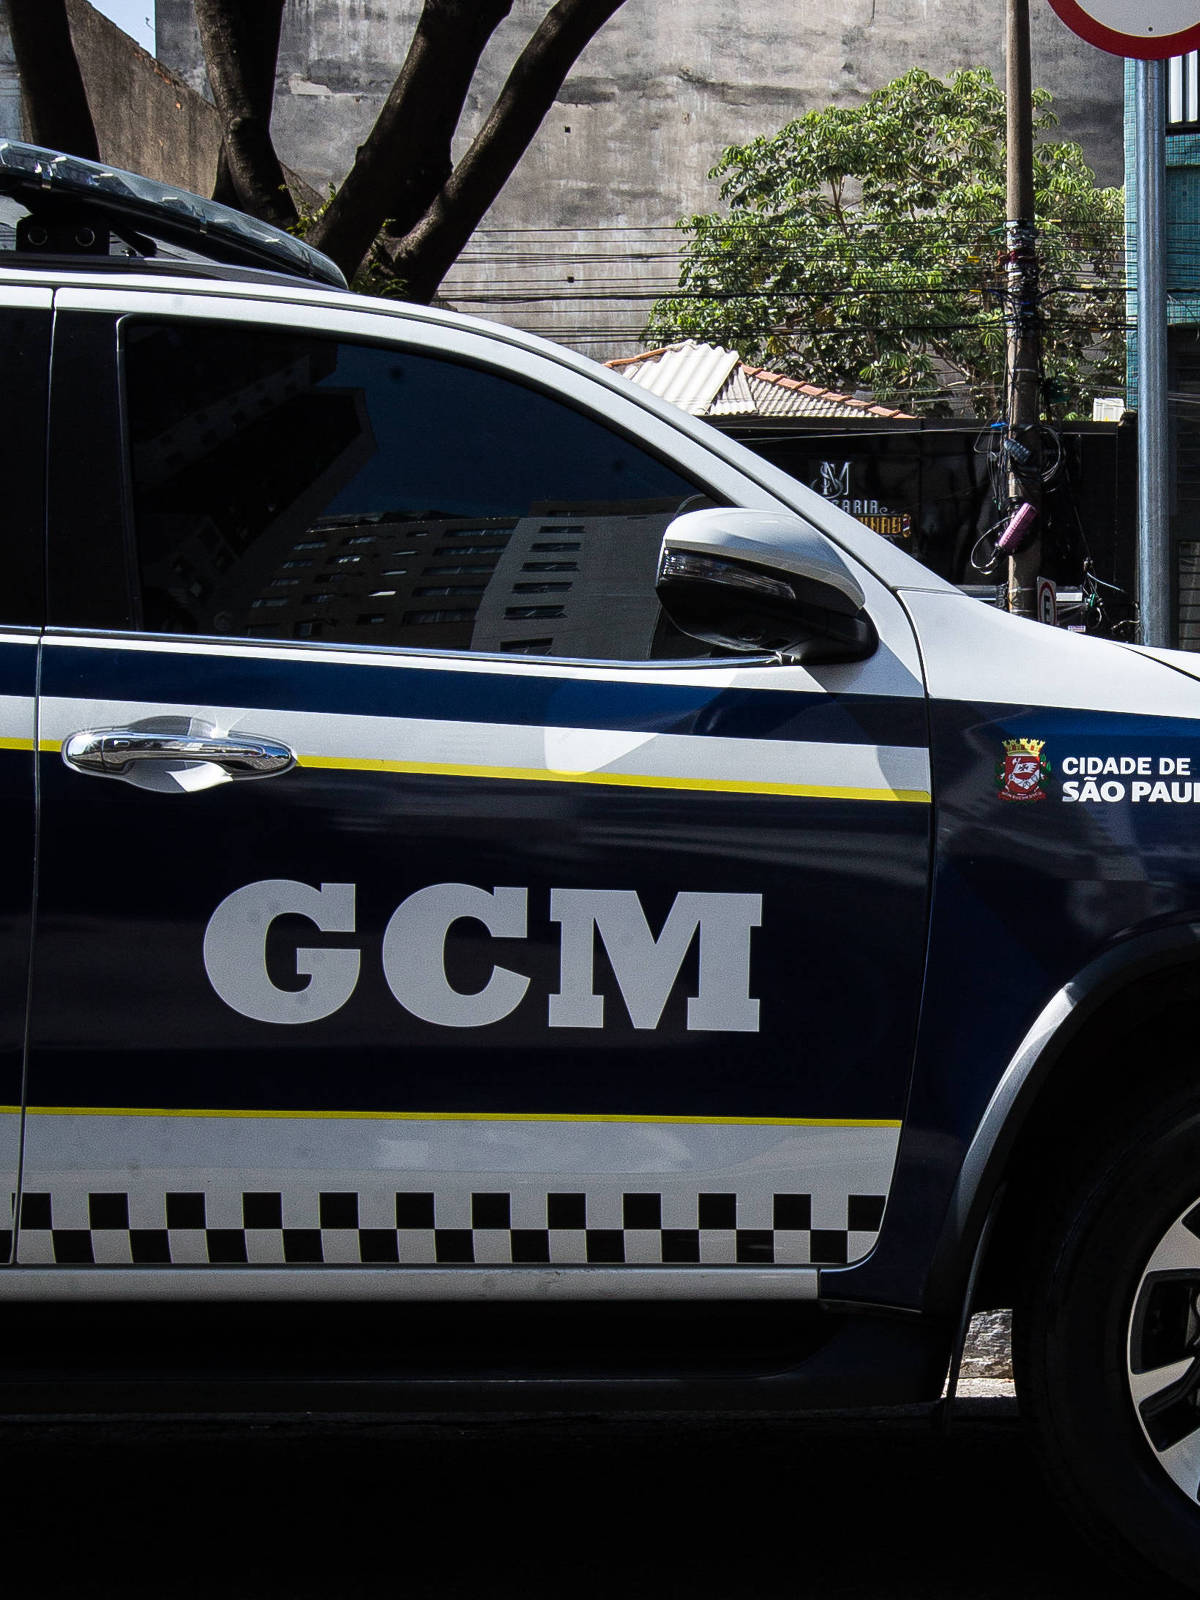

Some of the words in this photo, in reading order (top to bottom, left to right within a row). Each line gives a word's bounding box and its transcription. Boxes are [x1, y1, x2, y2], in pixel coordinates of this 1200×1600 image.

[1062, 757, 1152, 775] CIDADE
[1159, 758, 1190, 775] DE
[1062, 777, 1126, 803] SÃO
[203, 879, 763, 1033] GCM
